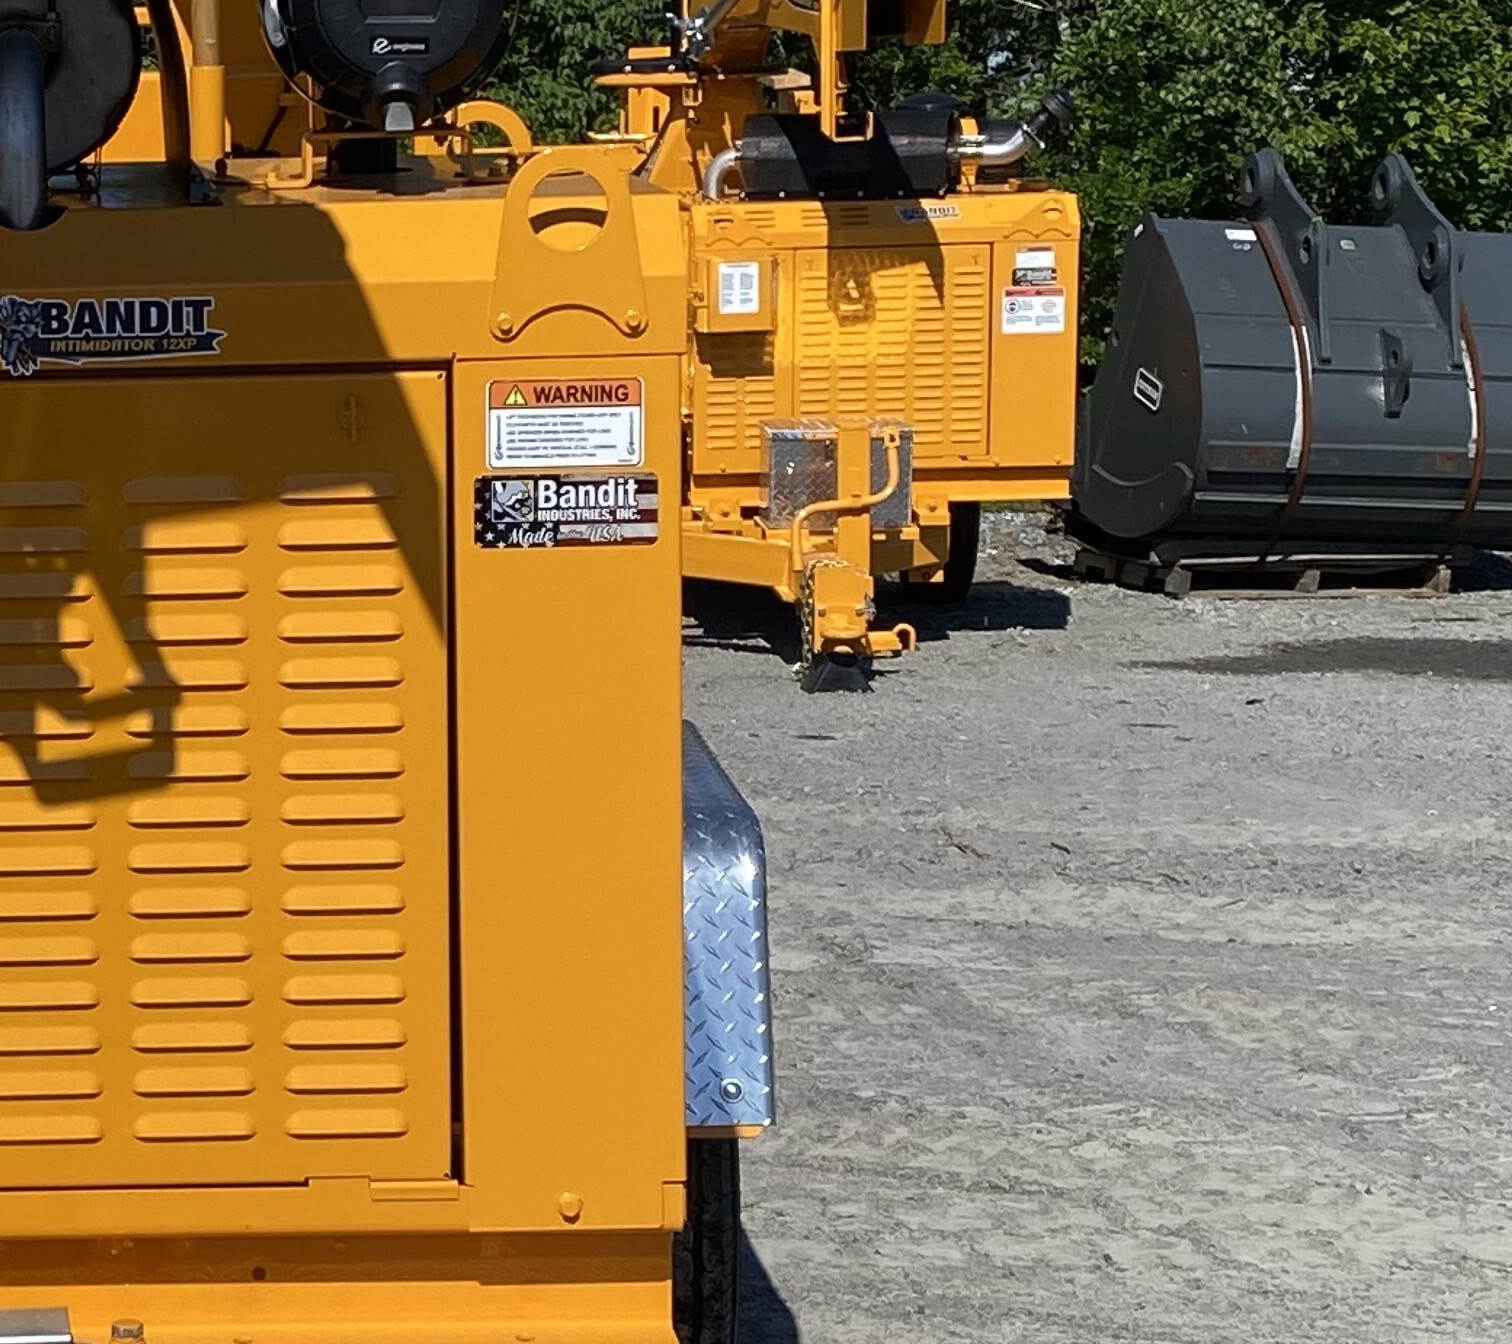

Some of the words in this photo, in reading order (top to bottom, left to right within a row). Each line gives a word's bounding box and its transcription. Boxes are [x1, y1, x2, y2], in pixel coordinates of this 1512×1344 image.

[40, 298, 213, 336] BANDIT
[49, 338, 155, 353] INTIMIDATOR
[161, 337, 197, 351] 12XP
[533, 384, 629, 404] WARNING
[537, 477, 639, 508] Bandit
[537, 508, 614, 522] INDUSTRIES,
[616, 507, 641, 521] INC.
[508, 525, 555, 545] Made
